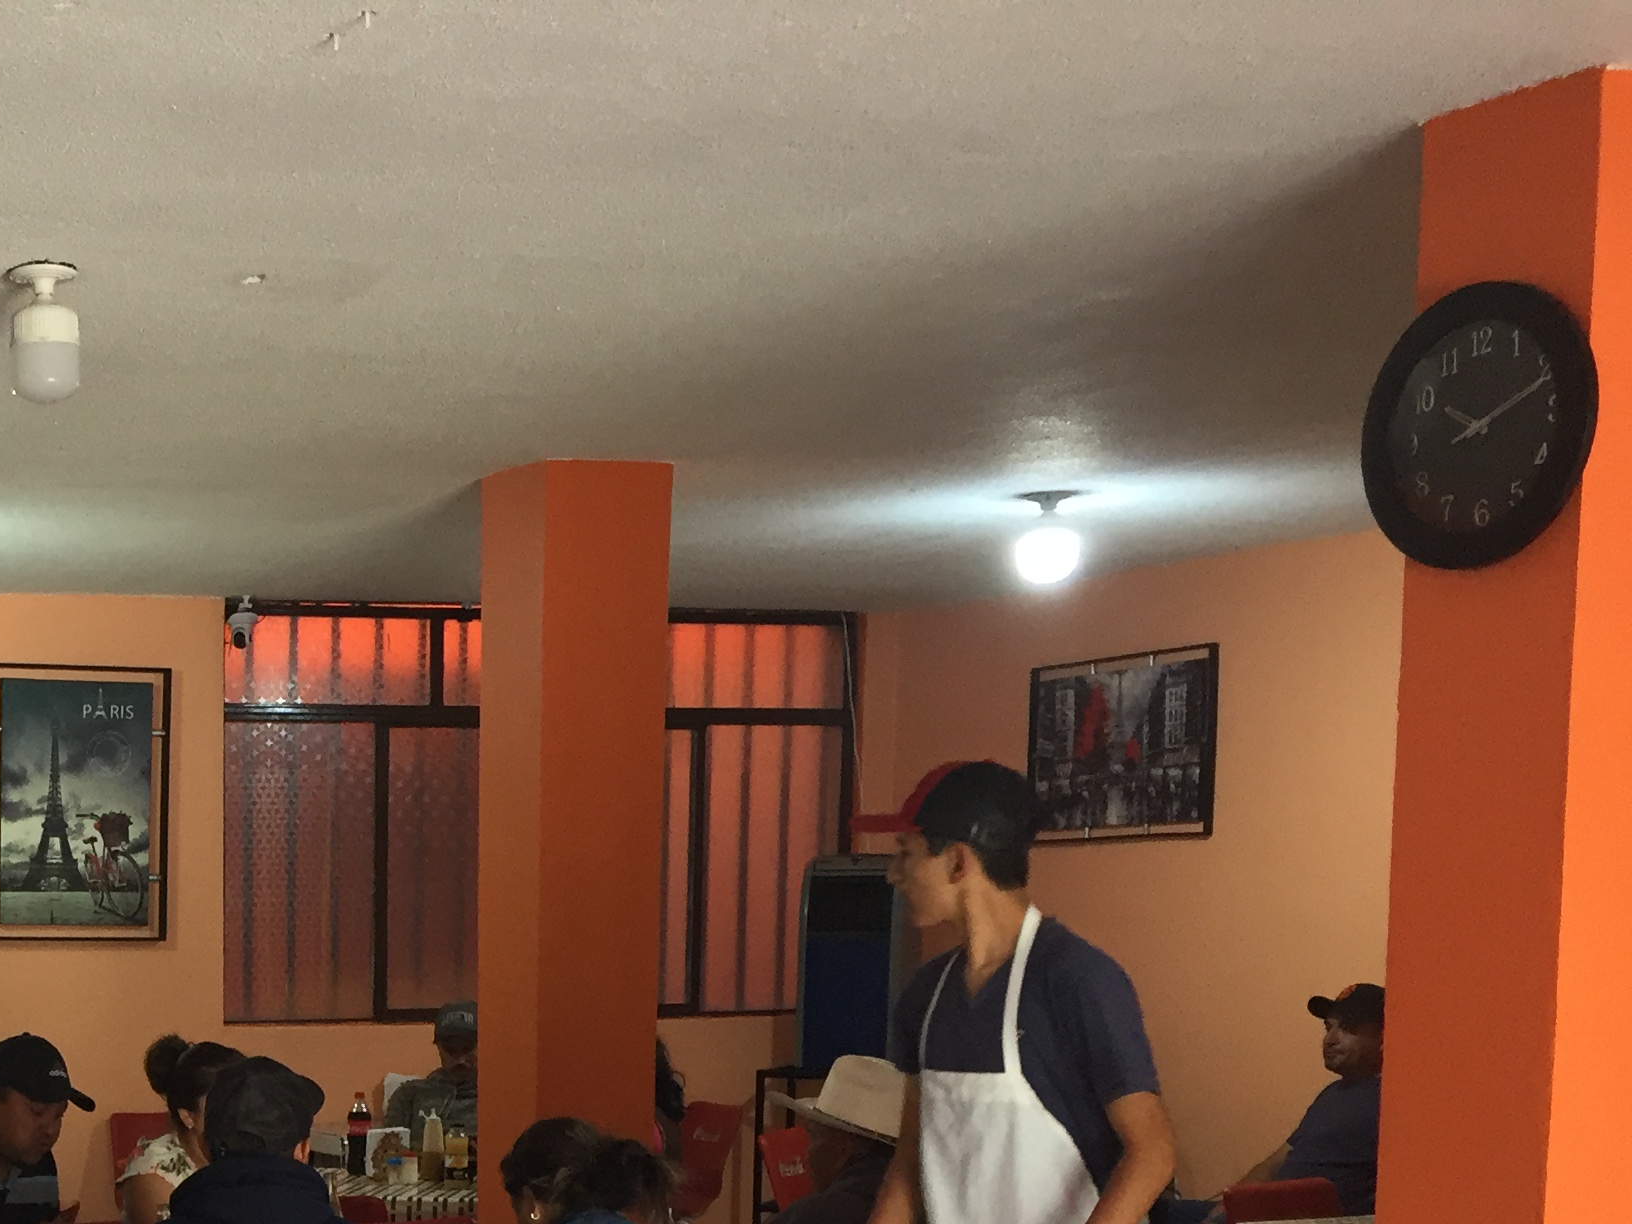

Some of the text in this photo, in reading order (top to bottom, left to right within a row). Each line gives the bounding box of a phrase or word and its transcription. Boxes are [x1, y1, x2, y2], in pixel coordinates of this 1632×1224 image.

[1471, 326, 1493, 357] 12
[1512, 330, 1520, 358] 1
[1440, 347, 1458, 377] 11
[1539, 354, 1552, 380] 2
[1416, 385, 1435, 414] 10
[1415, 471, 1429, 496] 8
[1509, 480, 1524, 506] 5
[1440, 495, 1455, 521] 7
[1474, 499, 1490, 526] 6
